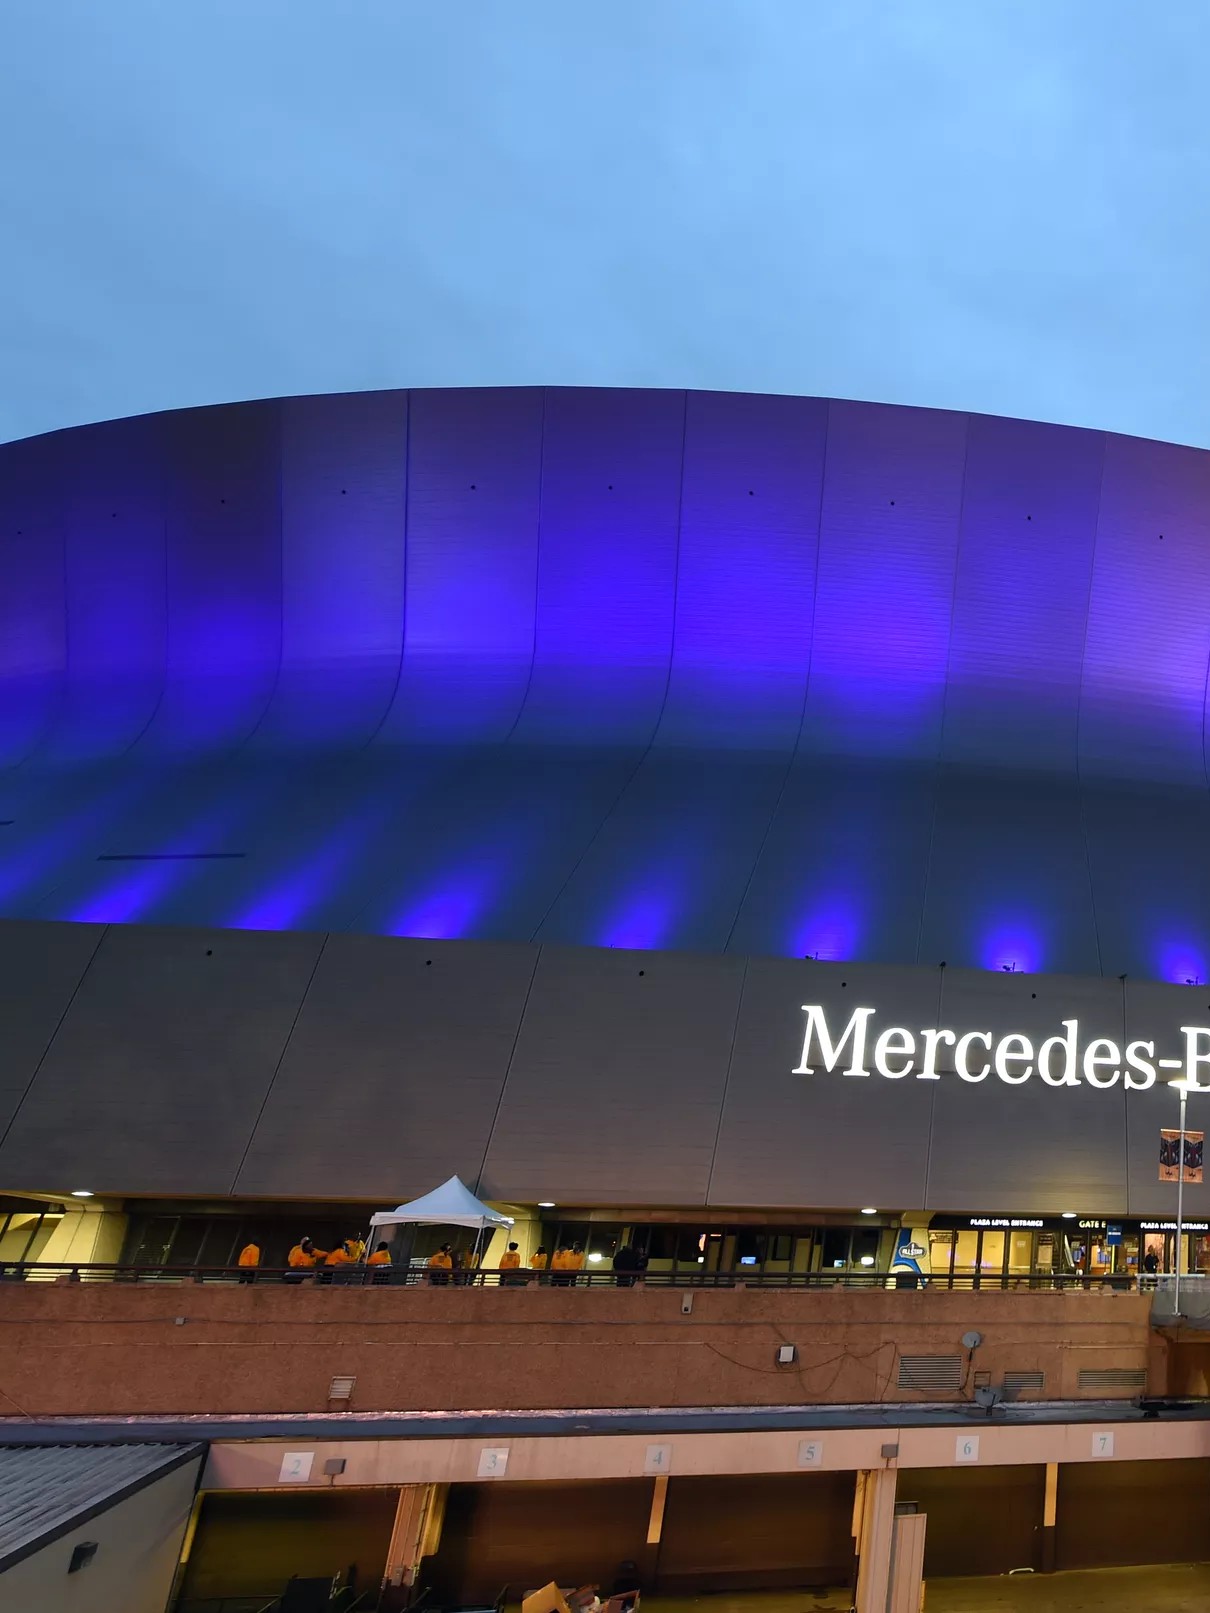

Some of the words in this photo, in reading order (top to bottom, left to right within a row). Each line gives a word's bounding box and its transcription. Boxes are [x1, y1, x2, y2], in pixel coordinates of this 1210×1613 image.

[970, 1218, 990, 1226] PLAZA
[1079, 1220, 1099, 1229] GATE
[1101, 1220, 1106, 1229] E
[1140, 1222, 1159, 1230] PLAZA
[963, 1441, 972, 1455] 6
[1099, 1437, 1107, 1450] 7
[653, 1450, 663, 1465] 4
[806, 1445, 815, 1460] 5
[290, 1459, 301, 1475] 2
[488, 1454, 498, 1470] 3
